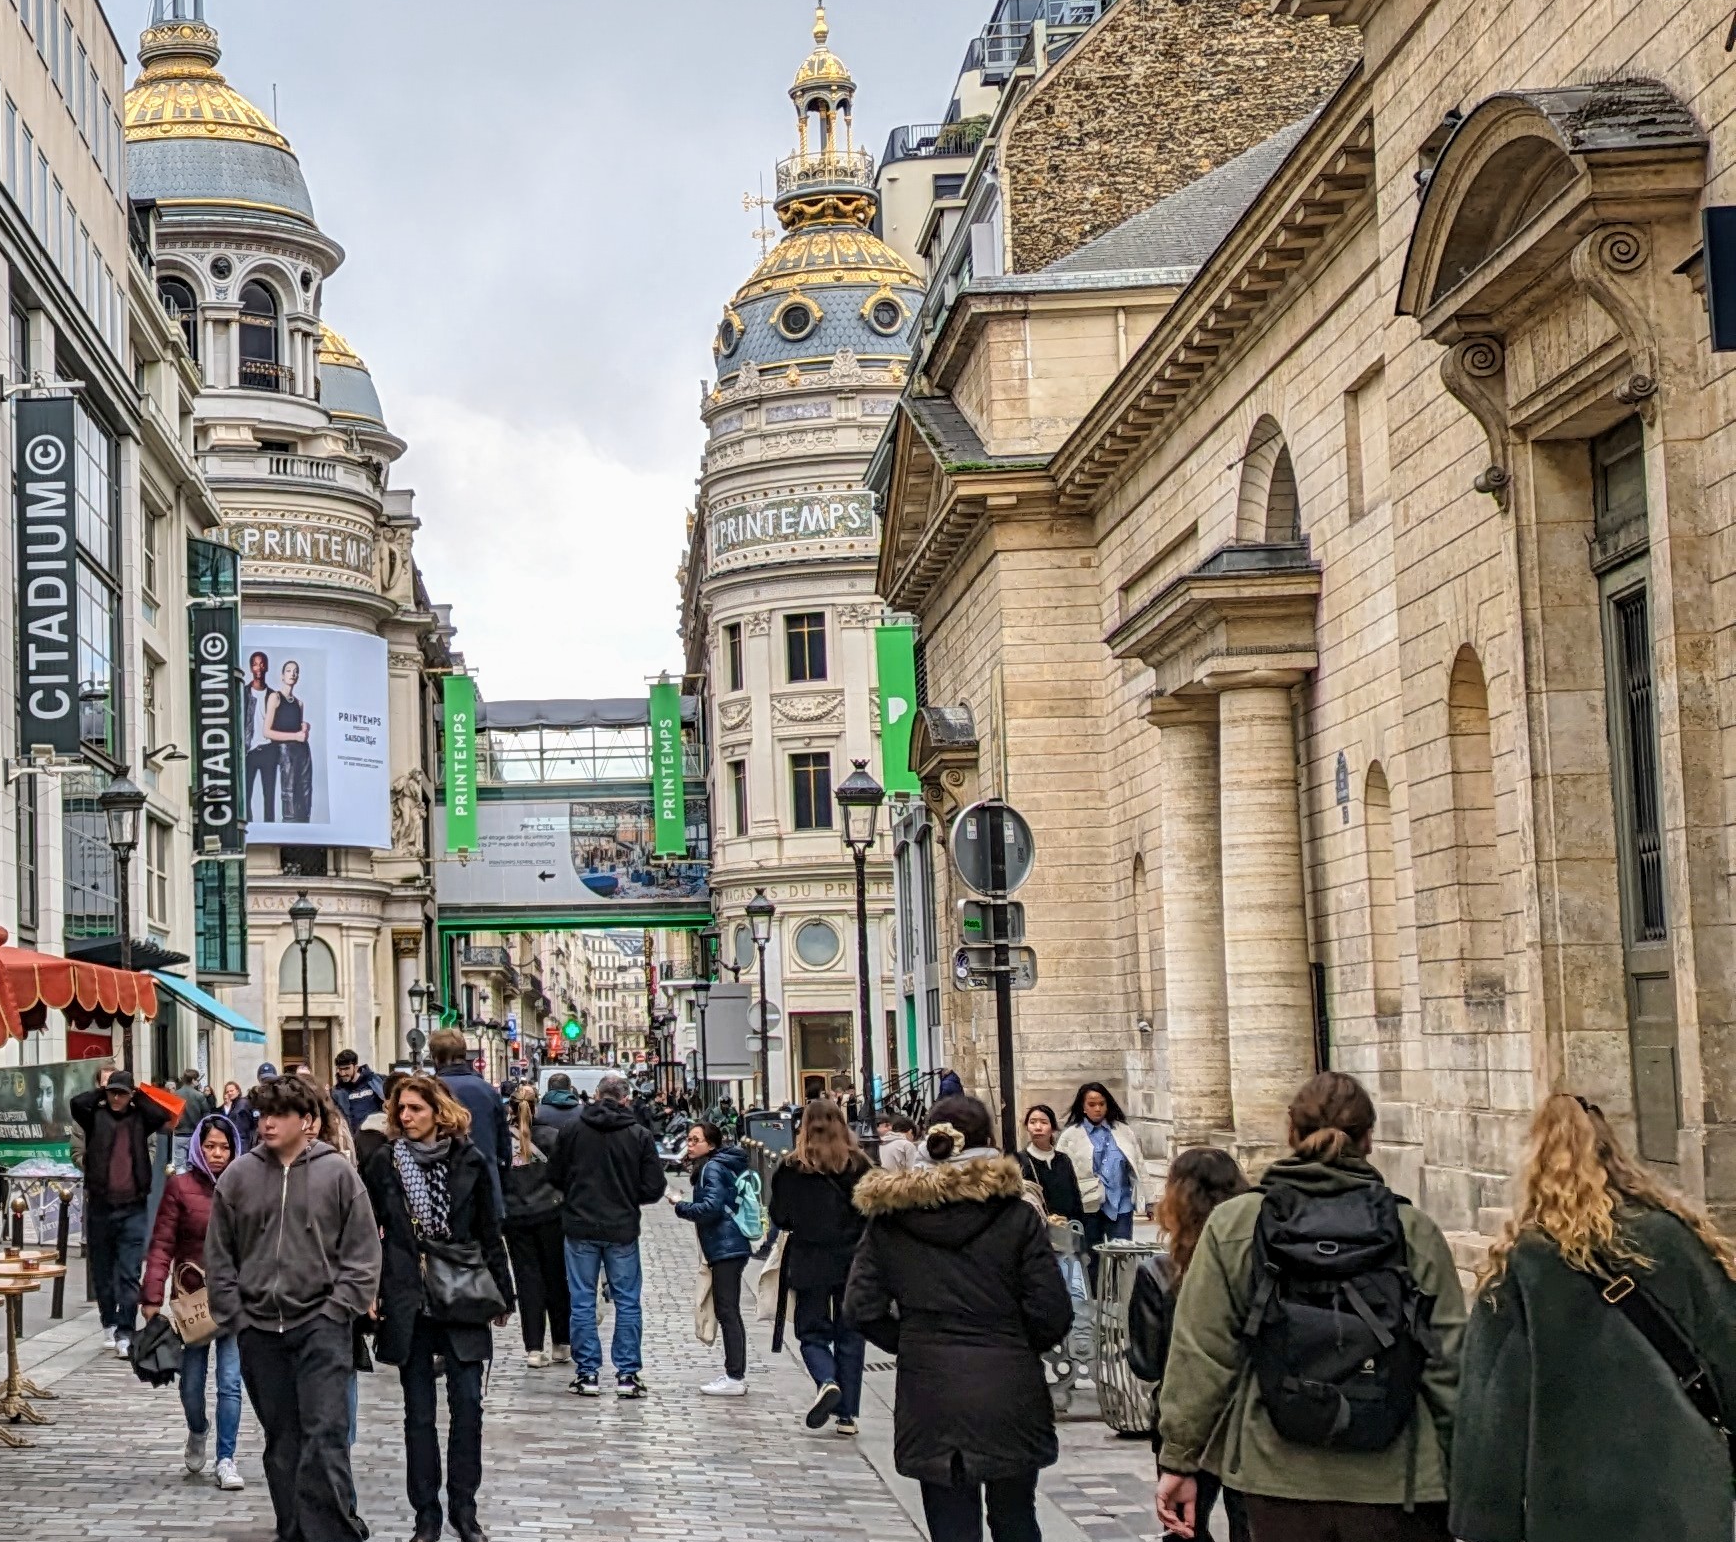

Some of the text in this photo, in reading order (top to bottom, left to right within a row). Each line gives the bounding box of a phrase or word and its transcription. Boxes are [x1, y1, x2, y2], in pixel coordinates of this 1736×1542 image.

[720, 502, 861, 550] PRINTEMPS
[244, 528, 372, 572] PRINTEMPS
[338, 711, 382, 727] PRINTEMPS
[453, 712, 468, 817] PRINTEMPS
[659, 718, 677, 821] PRINTEMPS
[789, 884, 812, 897] DU
[19, 1124, 32, 1139] FIN
[31, 1123, 43, 1139] AU
[181, 1311, 207, 1328] TOTE
